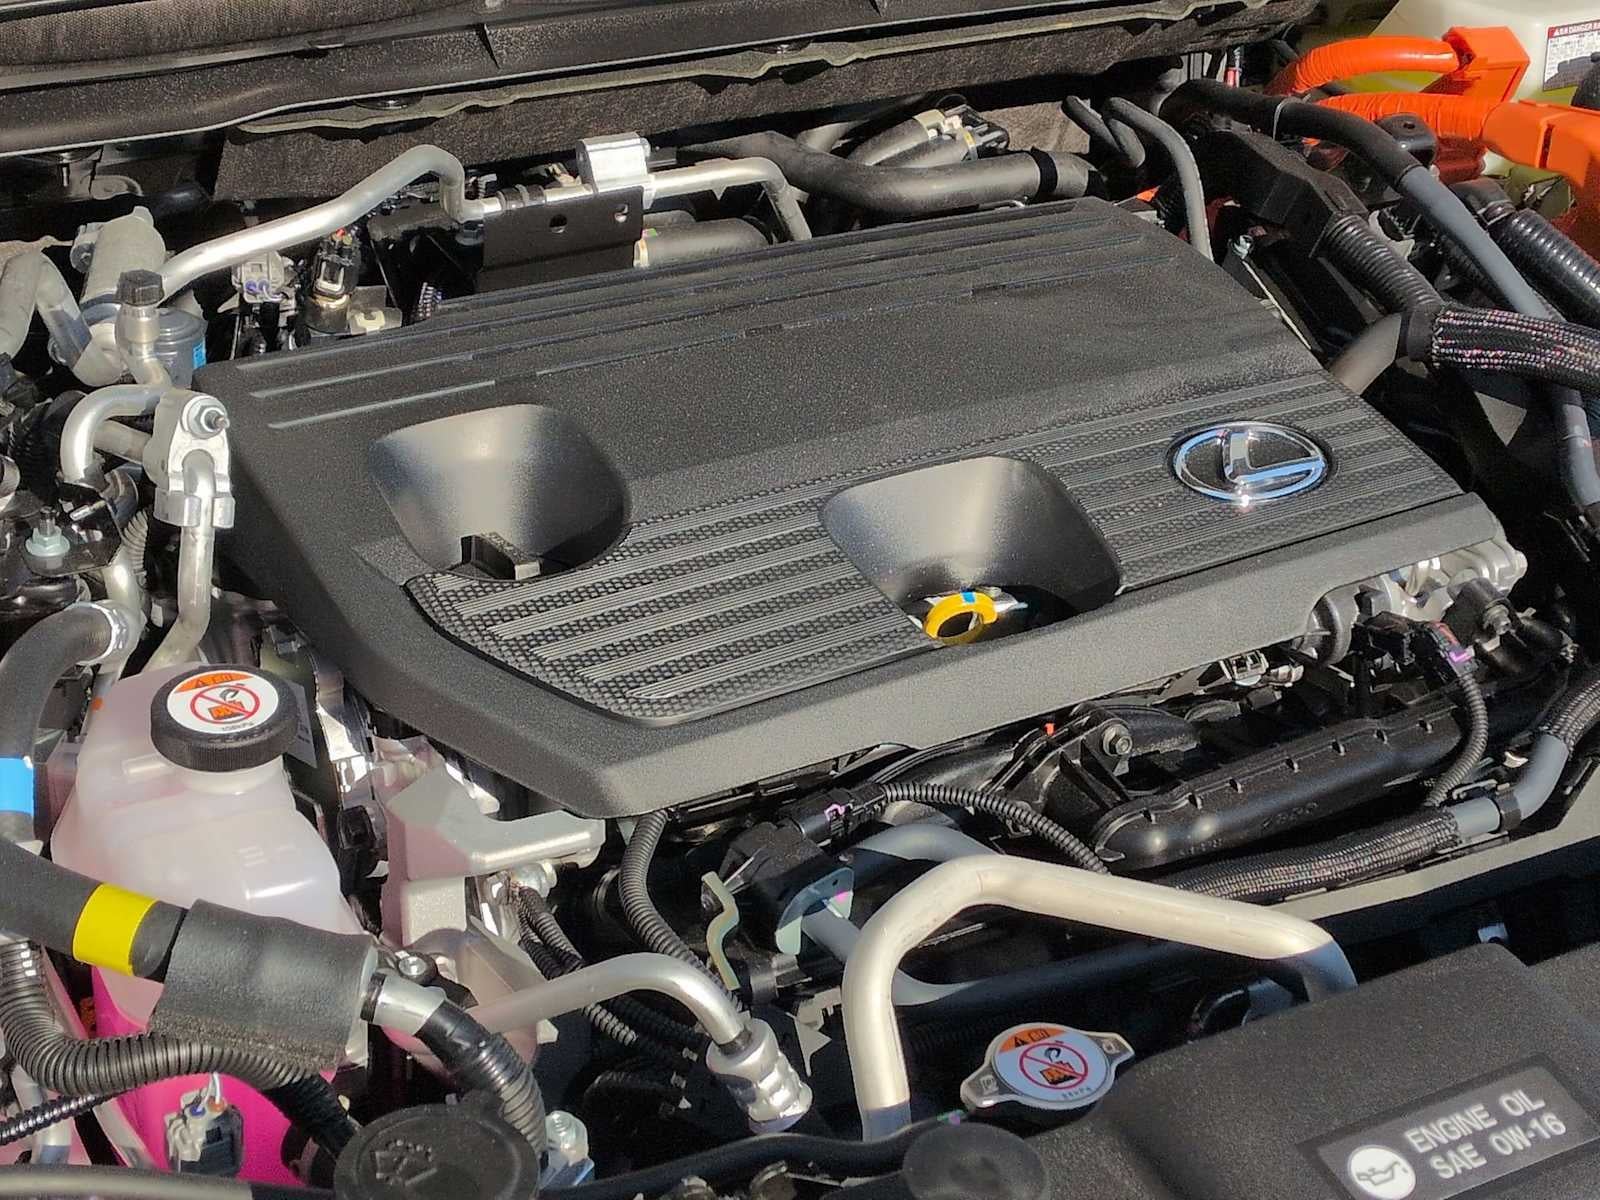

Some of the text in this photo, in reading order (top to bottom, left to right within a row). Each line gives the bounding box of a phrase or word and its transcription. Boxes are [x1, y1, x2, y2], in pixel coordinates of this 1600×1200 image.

[1404, 1090, 1545, 1153] ENGINE OIL
[1429, 1112, 1566, 1179] SAE 0W-16
